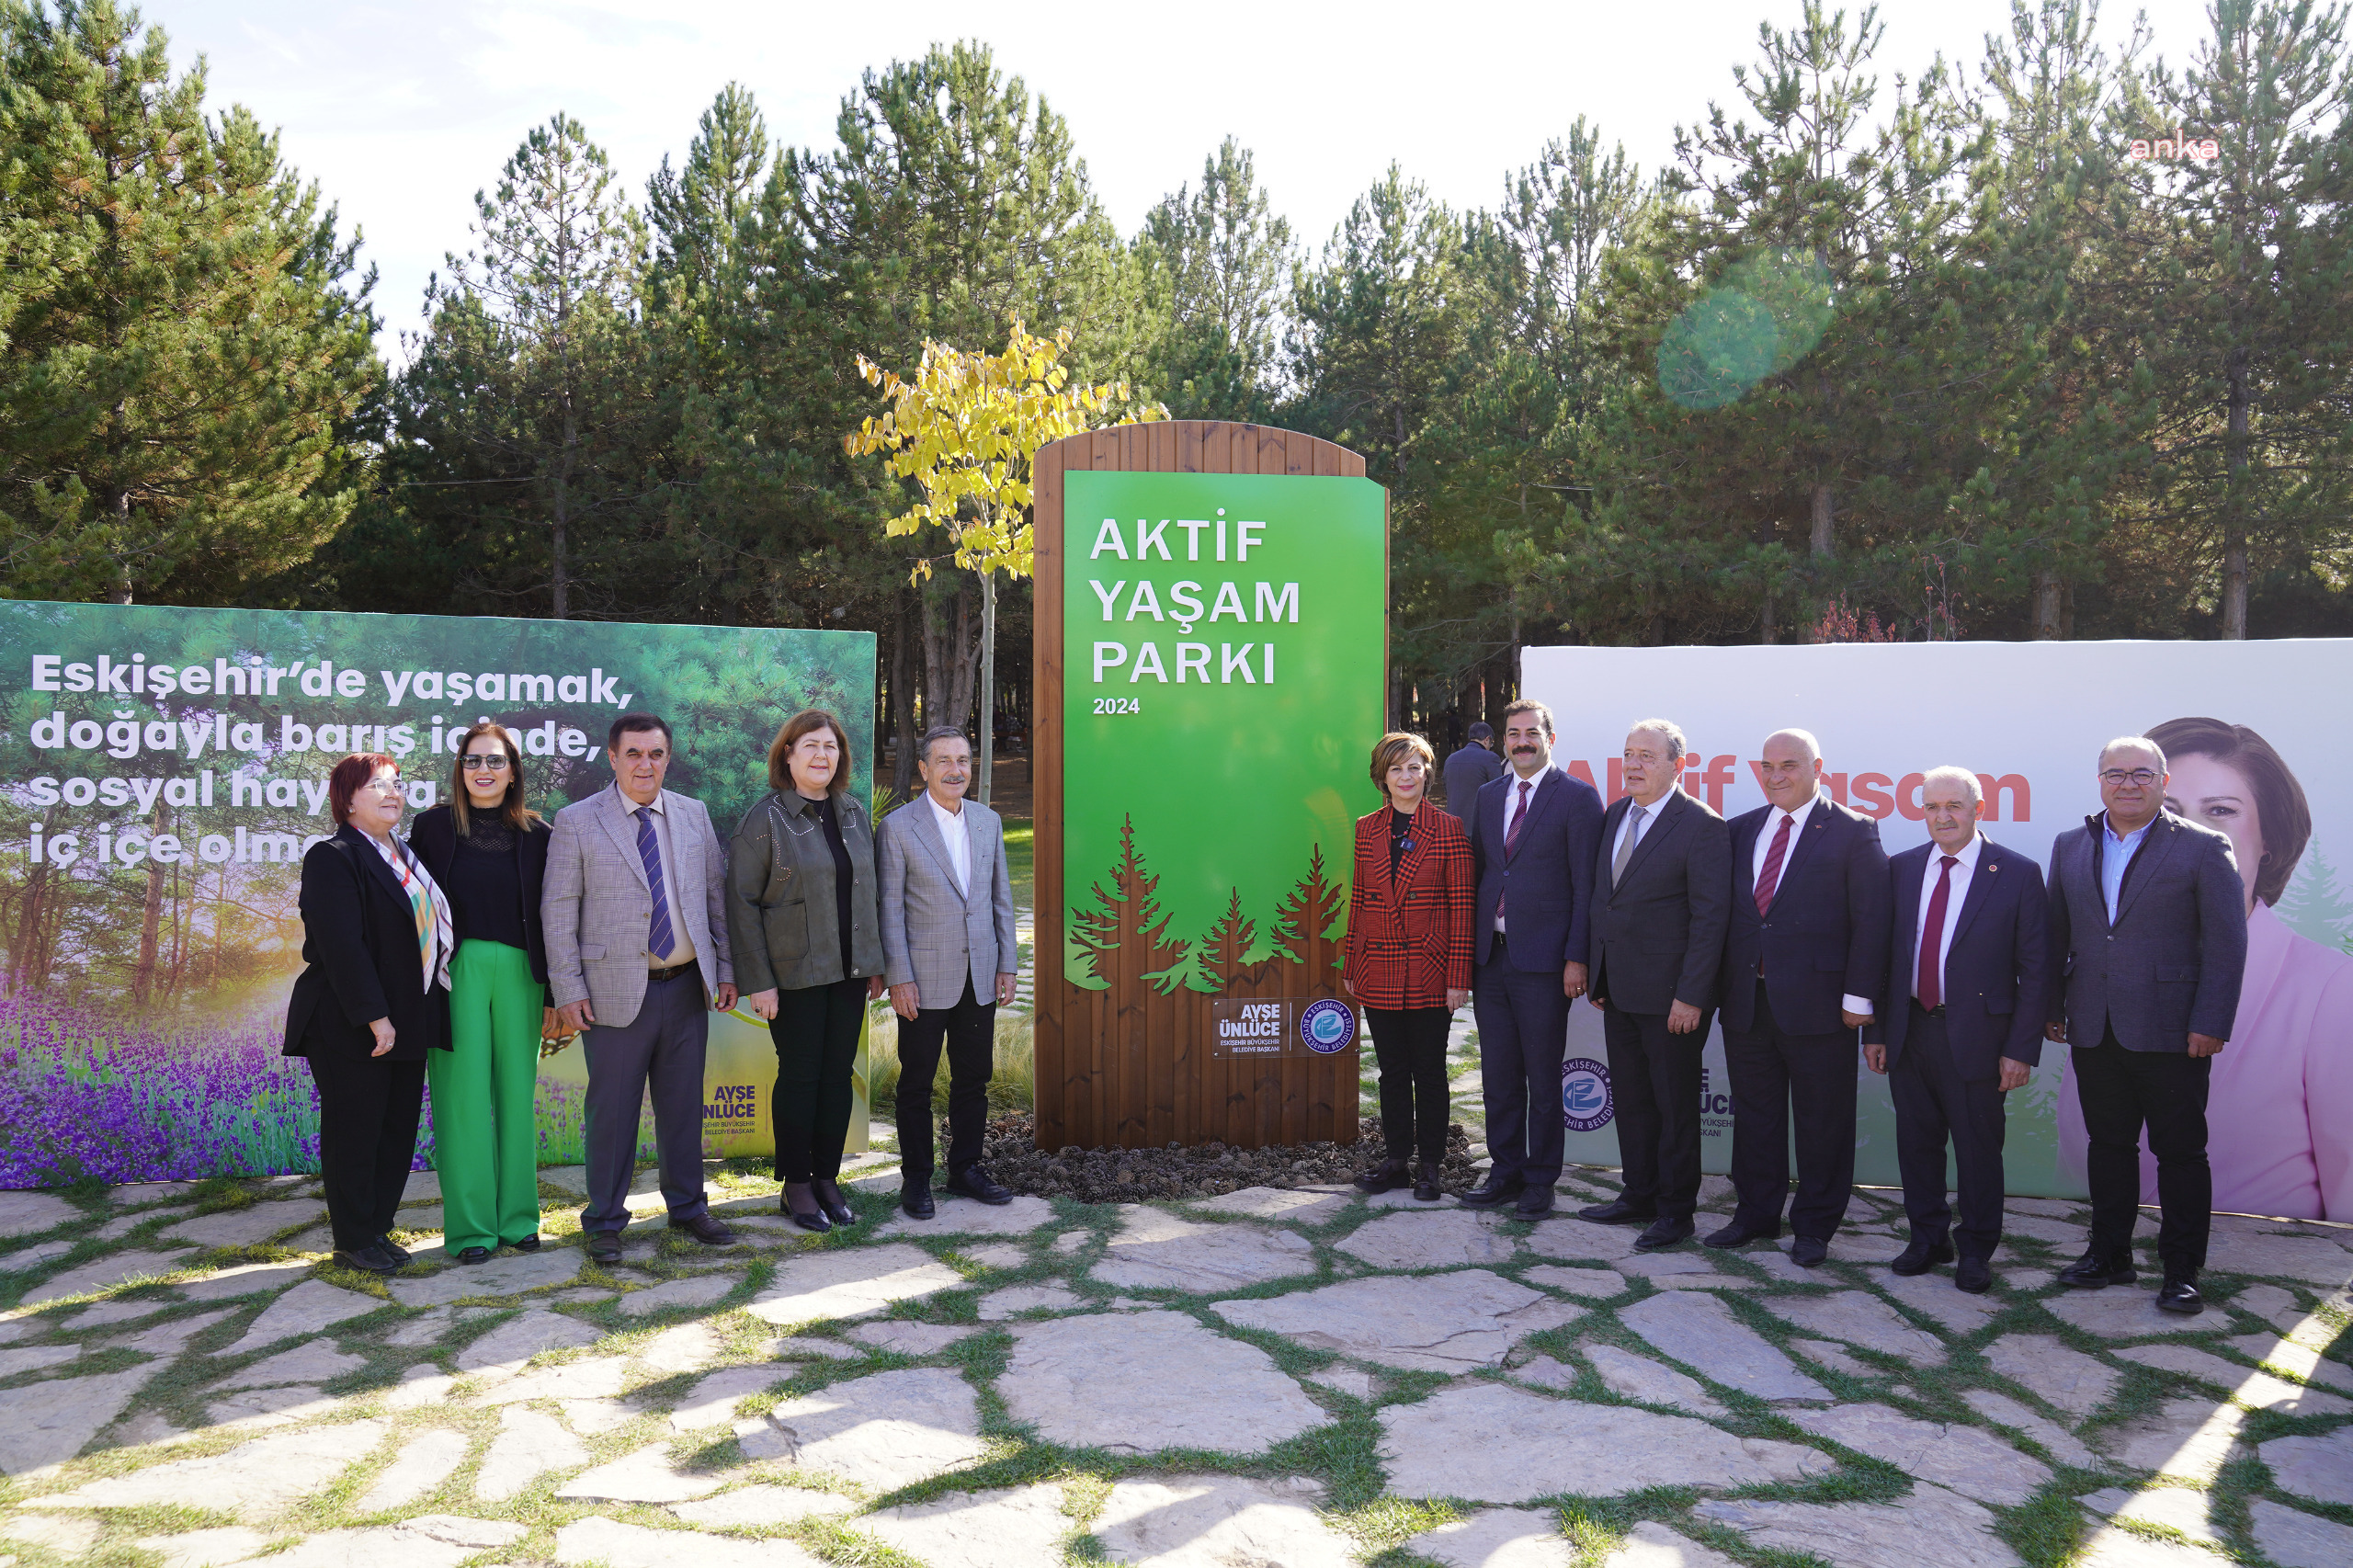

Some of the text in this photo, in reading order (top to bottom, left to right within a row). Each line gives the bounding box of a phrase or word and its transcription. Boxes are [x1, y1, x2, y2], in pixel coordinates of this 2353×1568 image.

[1089, 507, 1267, 562] AKTİF
[1088, 580, 1299, 634] YAŞAM
[1093, 642, 1275, 684] PARKI
[380, 667, 633, 710] yaşamak,
[1093, 698, 1140, 714] 2024
[30, 710, 264, 759] doğayla
[281, 715, 415, 759] barış
[30, 769, 212, 815] sosyal
[30, 823, 80, 869] iç
[97, 823, 182, 869] içe
[1241, 1004, 1280, 1021] AYŞE
[1310, 1002, 1344, 1015] ESKİŞEHİR
[1219, 1018, 1280, 1038] ÜNLÜCE
[1232, 1045, 1280, 1053] BELEDİYE BAŞKANI
[1246, 1038, 1280, 1046] BÜYÜKŞEHİR
[714, 1085, 756, 1102] AYŞE
[703, 1100, 756, 1119] NLÜCE
